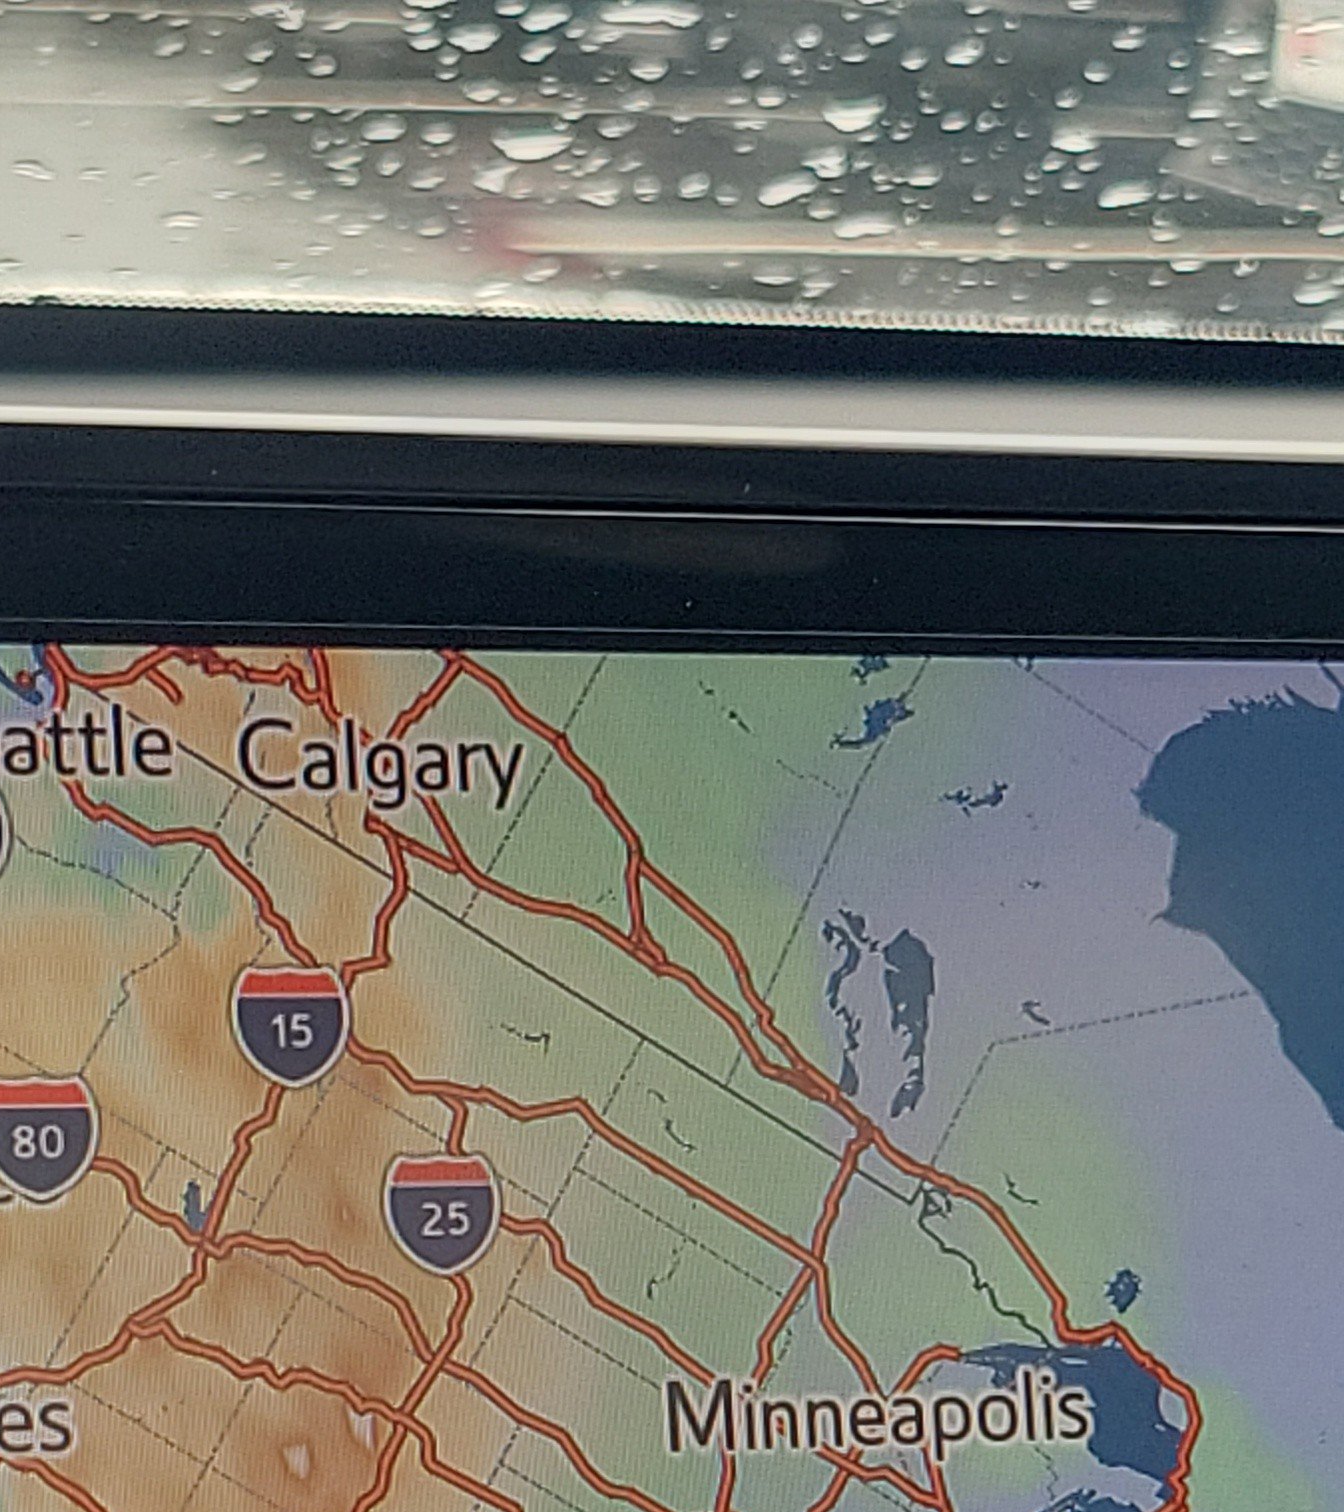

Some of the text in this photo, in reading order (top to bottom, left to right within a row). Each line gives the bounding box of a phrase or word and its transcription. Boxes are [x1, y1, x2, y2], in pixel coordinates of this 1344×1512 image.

[238, 717, 524, 809] Calgary
[270, 1013, 314, 1050] 15
[11, 1124, 65, 1160] 80
[418, 1202, 470, 1238] 25
[664, 1366, 1093, 1461] Minneapolis
